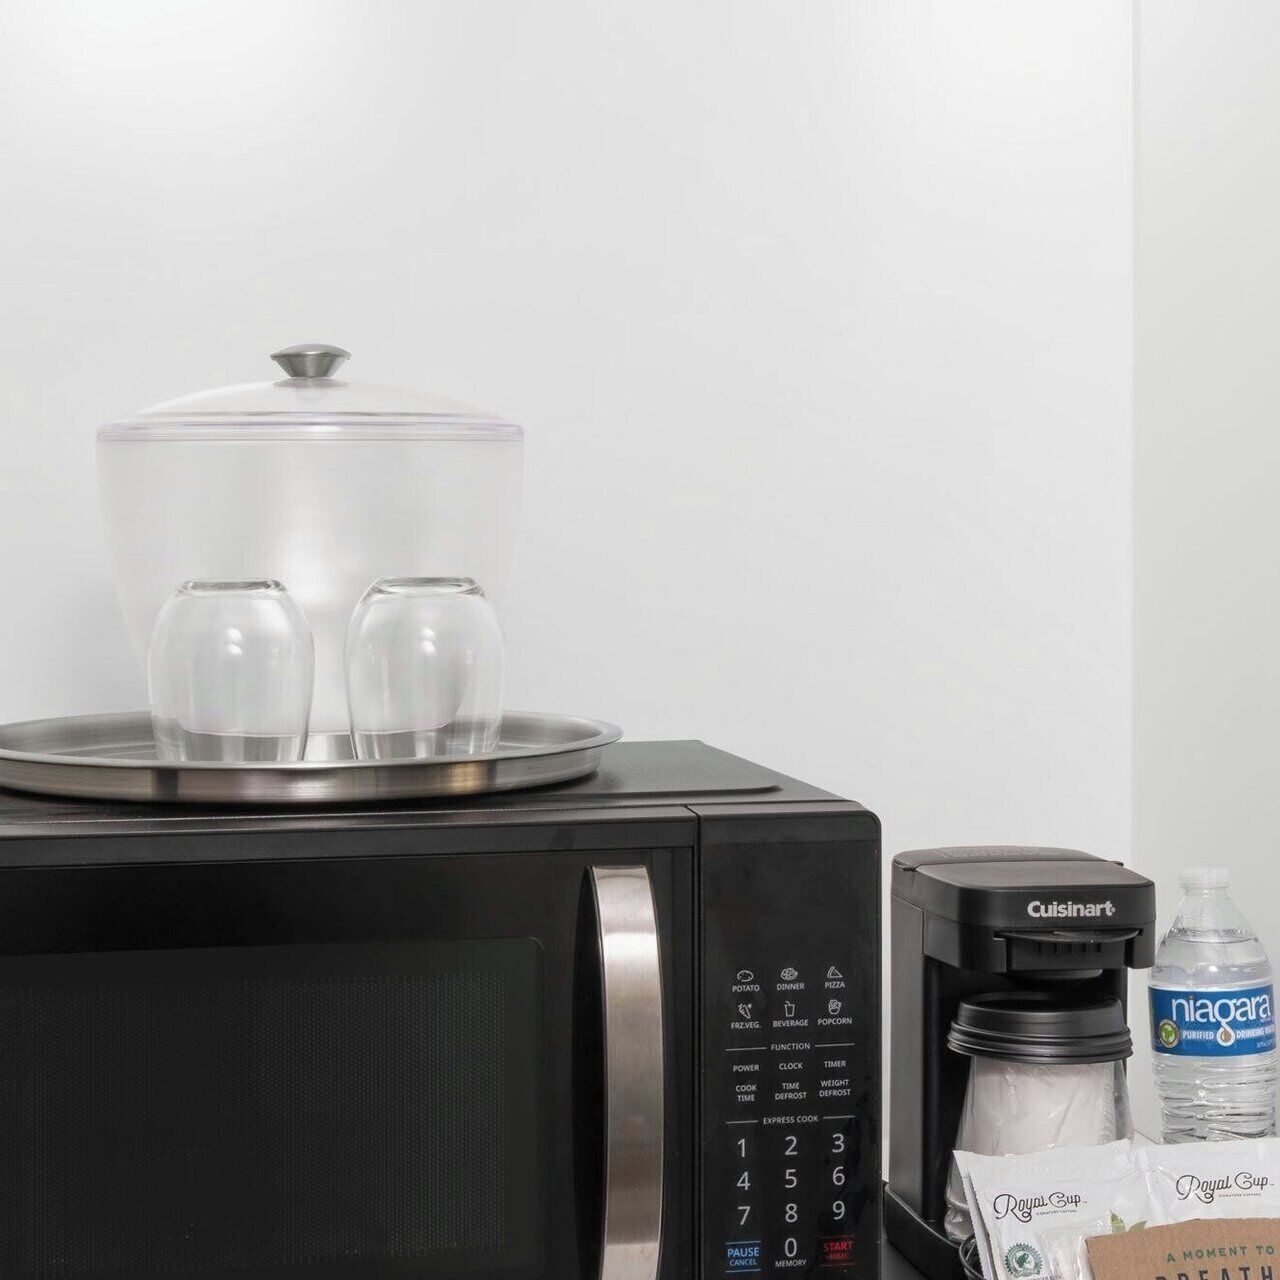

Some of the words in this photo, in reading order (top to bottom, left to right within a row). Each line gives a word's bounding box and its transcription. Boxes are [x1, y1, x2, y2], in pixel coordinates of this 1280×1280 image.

[1027, 901, 1112, 918] Cuisinart
[732, 984, 760, 992] POTATO
[776, 983, 805, 991] DINNER
[824, 981, 846, 989] PIZZA
[772, 1019, 809, 1028] BEVERAGE
[818, 1017, 852, 1026] POPCORN
[1171, 994, 1271, 1047] niagara
[1182, 1030, 1214, 1040] PURIFIED
[1236, 1028, 1265, 1040] DRINKING
[770, 1042, 811, 1050] FUNCTION
[733, 1064, 760, 1072] POWER
[778, 1062, 804, 1070] CLOCK
[823, 1060, 847, 1068] TIMER
[735, 1084, 757, 1092] COOK
[782, 1082, 800, 1090] TIME
[820, 1079, 850, 1087] WEIGHT
[737, 1094, 756, 1102] TIME
[774, 1092, 807, 1100] DEFROST
[819, 1089, 851, 1097] DEFROST
[763, 1116, 795, 1125] EXPRESS
[796, 1115, 819, 1123] COOK
[784, 1135, 798, 1156] 2
[831, 1133, 845, 1153] 3
[737, 1138, 747, 1159] 1
[736, 1171, 751, 1191] 4
[784, 1169, 798, 1188] 5
[832, 1166, 846, 1186] 6
[1175, 1174, 1233, 1204] Royal
[1234, 1171, 1269, 1190] Cup
[832, 1200, 846, 1220] 9
[993, 1193, 1048, 1223] Royal
[1048, 1191, 1081, 1208] Cup
[737, 1205, 751, 1226] 7
[785, 1203, 799, 1223] 8
[784, 1237, 798, 1257] 0
[823, 1241, 853, 1251] START
[727, 1247, 760, 1258] PAUSE
[1166, 1253, 1176, 1263] A
[1183, 1245, 1248, 1261] MOMENT
[1255, 1245, 1275, 1256] TO
[729, 1258, 757, 1267] CANCEL
[775, 1259, 808, 1268] MEMORY
